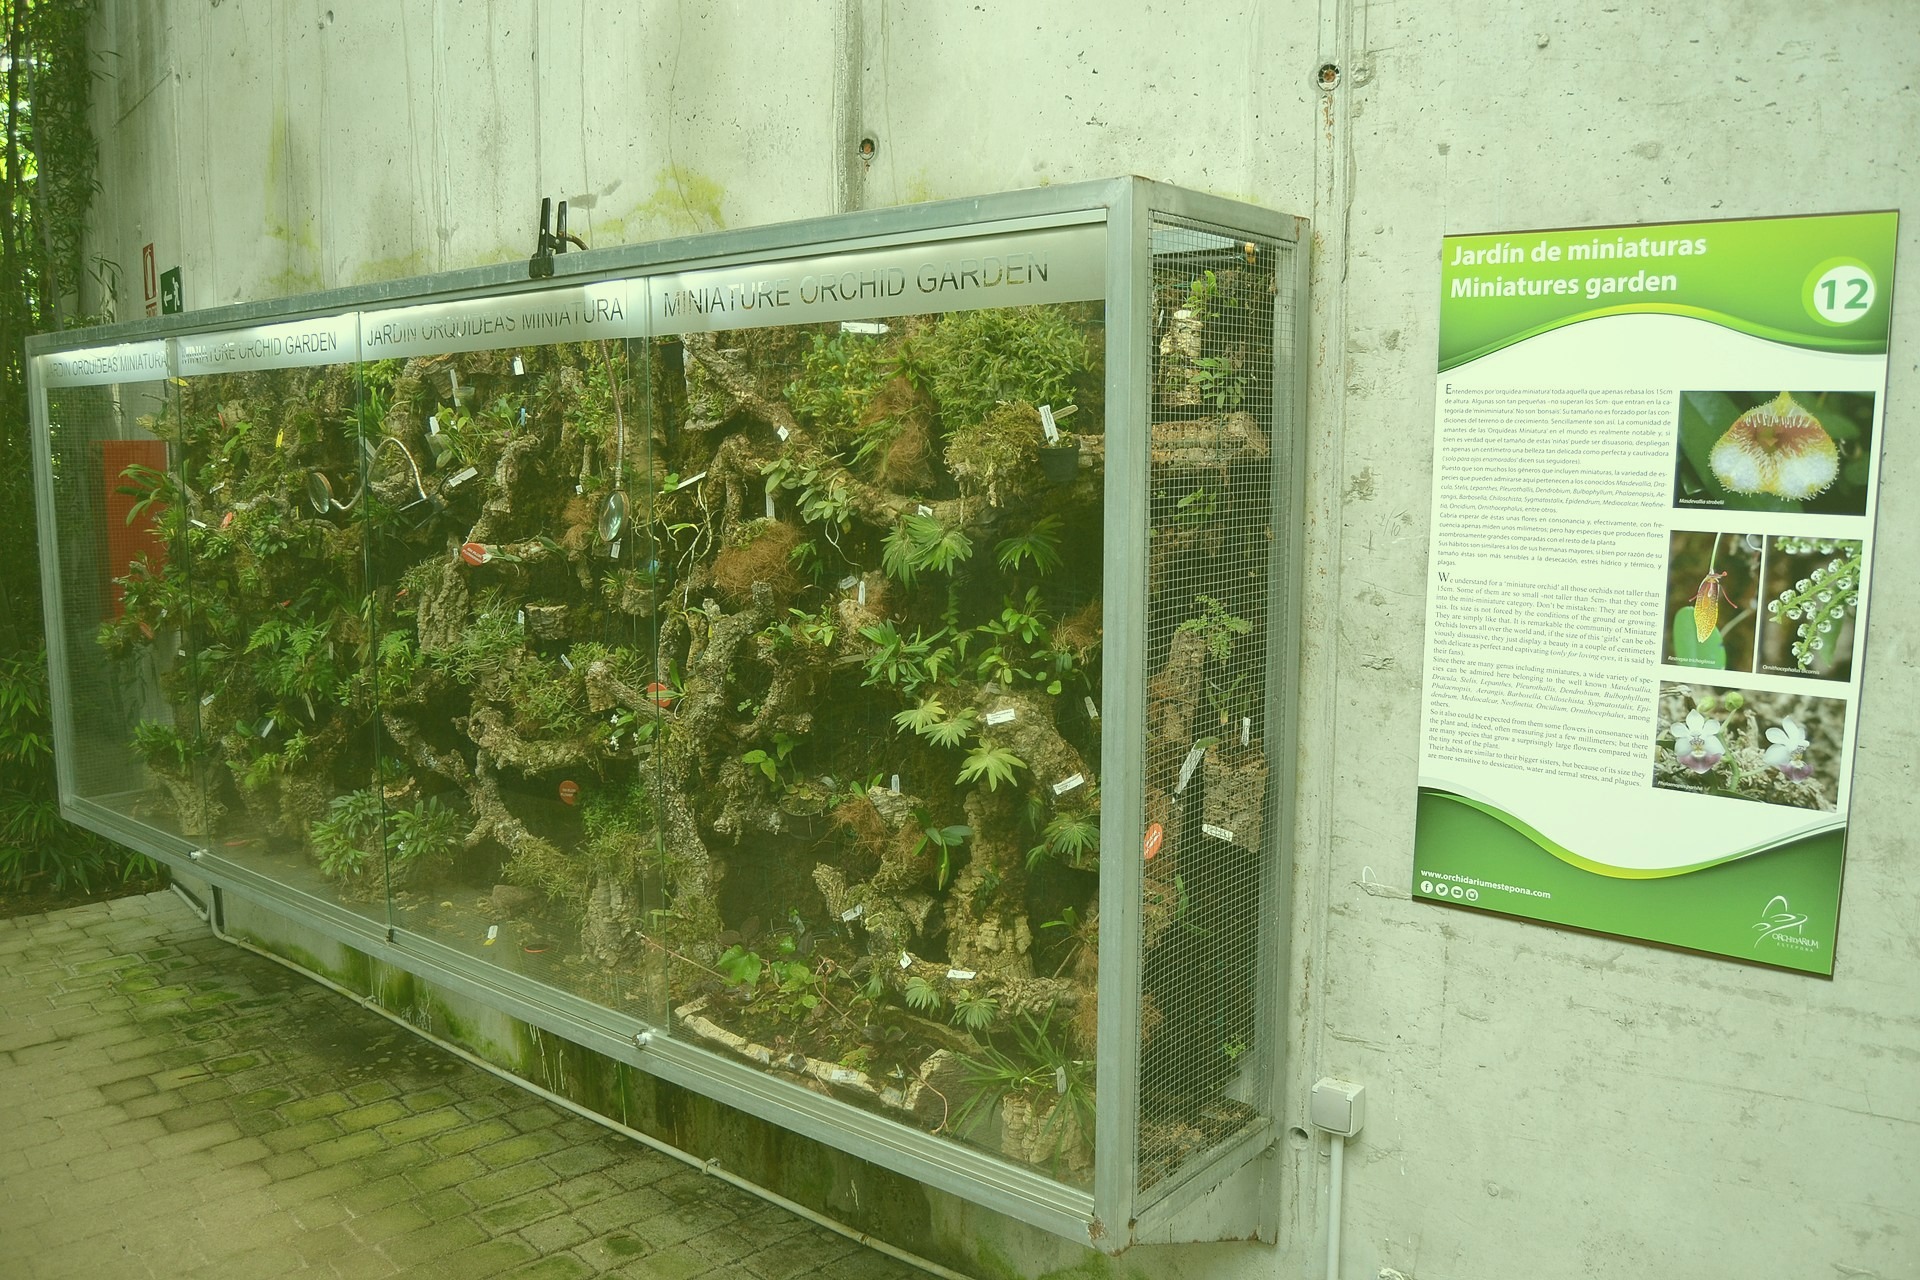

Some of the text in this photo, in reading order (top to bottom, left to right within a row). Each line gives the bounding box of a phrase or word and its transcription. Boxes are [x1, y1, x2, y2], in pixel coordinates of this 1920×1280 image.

[1450, 236, 1707, 266] Jardín de miniaturas
[664, 250, 1048, 318] MINIATURE ORCHID GARDEN
[1450, 270, 1677, 300] Miniatures garden
[1821, 278, 1868, 310] 12
[367, 297, 624, 347] JARDIN ORQUIDEAS MINIATURA
[181, 332, 337, 365] MINIATURE ORCHID GARDEN
[73, 357, 118, 376] ORQUIDEAS
[120, 353, 168, 372] MINIATURA
[1446, 384, 1484, 394] Entendemos
[1484, 389, 1494, 397] por
[1570, 438, 1590, 447] puede
[1635, 440, 1670, 448] despliegan
[1438, 572, 1453, 582] We
[1588, 586, 1613, 594] orchids
[1460, 596, 1505, 605] mini-miniature
[1507, 601, 1536, 609] category.
[1599, 606, 1616, 615] They
[1624, 598, 1638, 608] they
[1428, 742, 1444, 751] Their
[1445, 744, 1463, 754] habits
[1474, 749, 1495, 758] similar
[1519, 755, 1538, 765] bigger
[1540, 758, 1562, 767] sisters,
[1562, 760, 1572, 768] but
[1573, 762, 1599, 772] because
[1608, 766, 1616, 774] its
[1617, 768, 1630, 776] size
[1632, 770, 1645, 780] they
[1454, 756, 1480, 765] sensitive
[1558, 770, 1578, 778] termal
[1420, 870, 1551, 899] www.orchidariumestepona.com
[1772, 933, 1818, 949] ORCHIDARIUM
[1777, 942, 1814, 952] ESTEPONA
